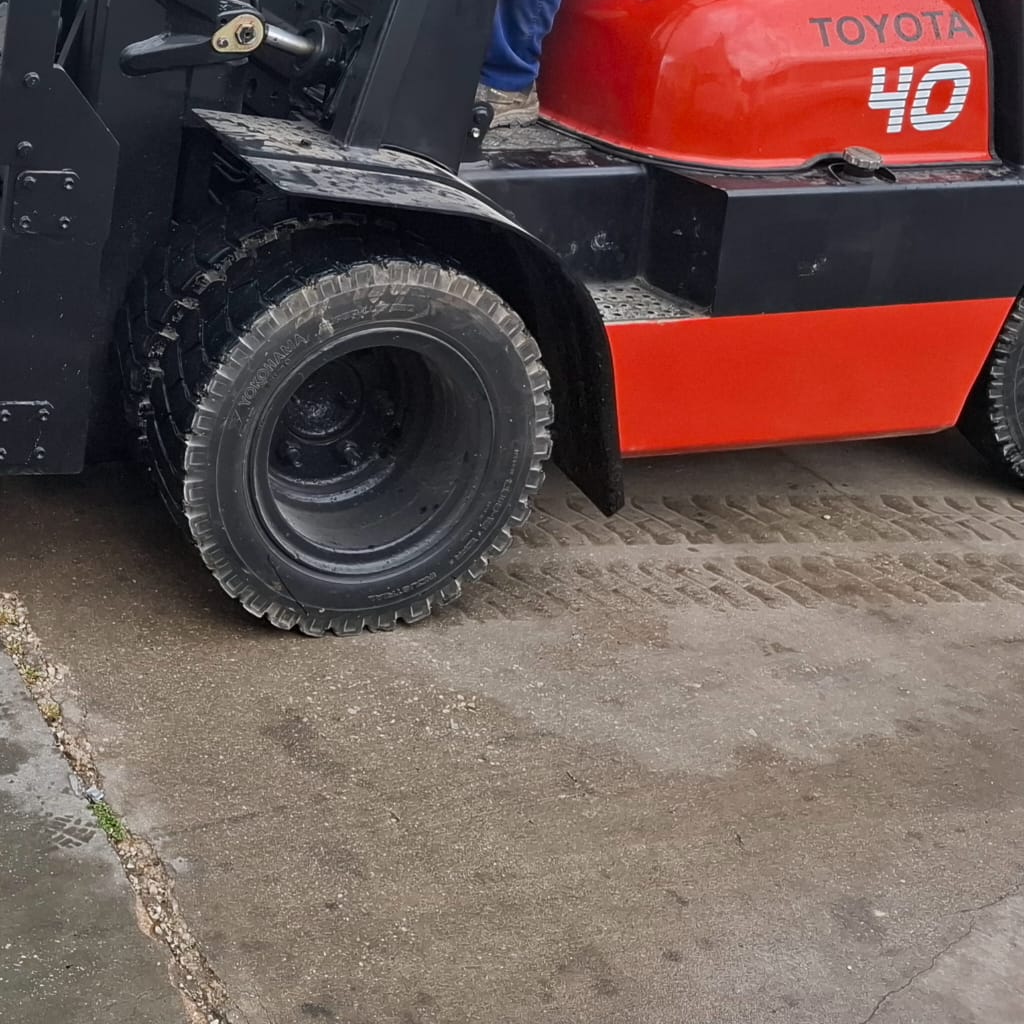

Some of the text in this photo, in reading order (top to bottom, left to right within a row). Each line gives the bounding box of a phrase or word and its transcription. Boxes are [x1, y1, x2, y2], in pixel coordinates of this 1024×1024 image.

[809, 10, 974, 48] TOYOTA
[868, 62, 971, 134] 40
[237, 333, 309, 407] YOKOHAMA
